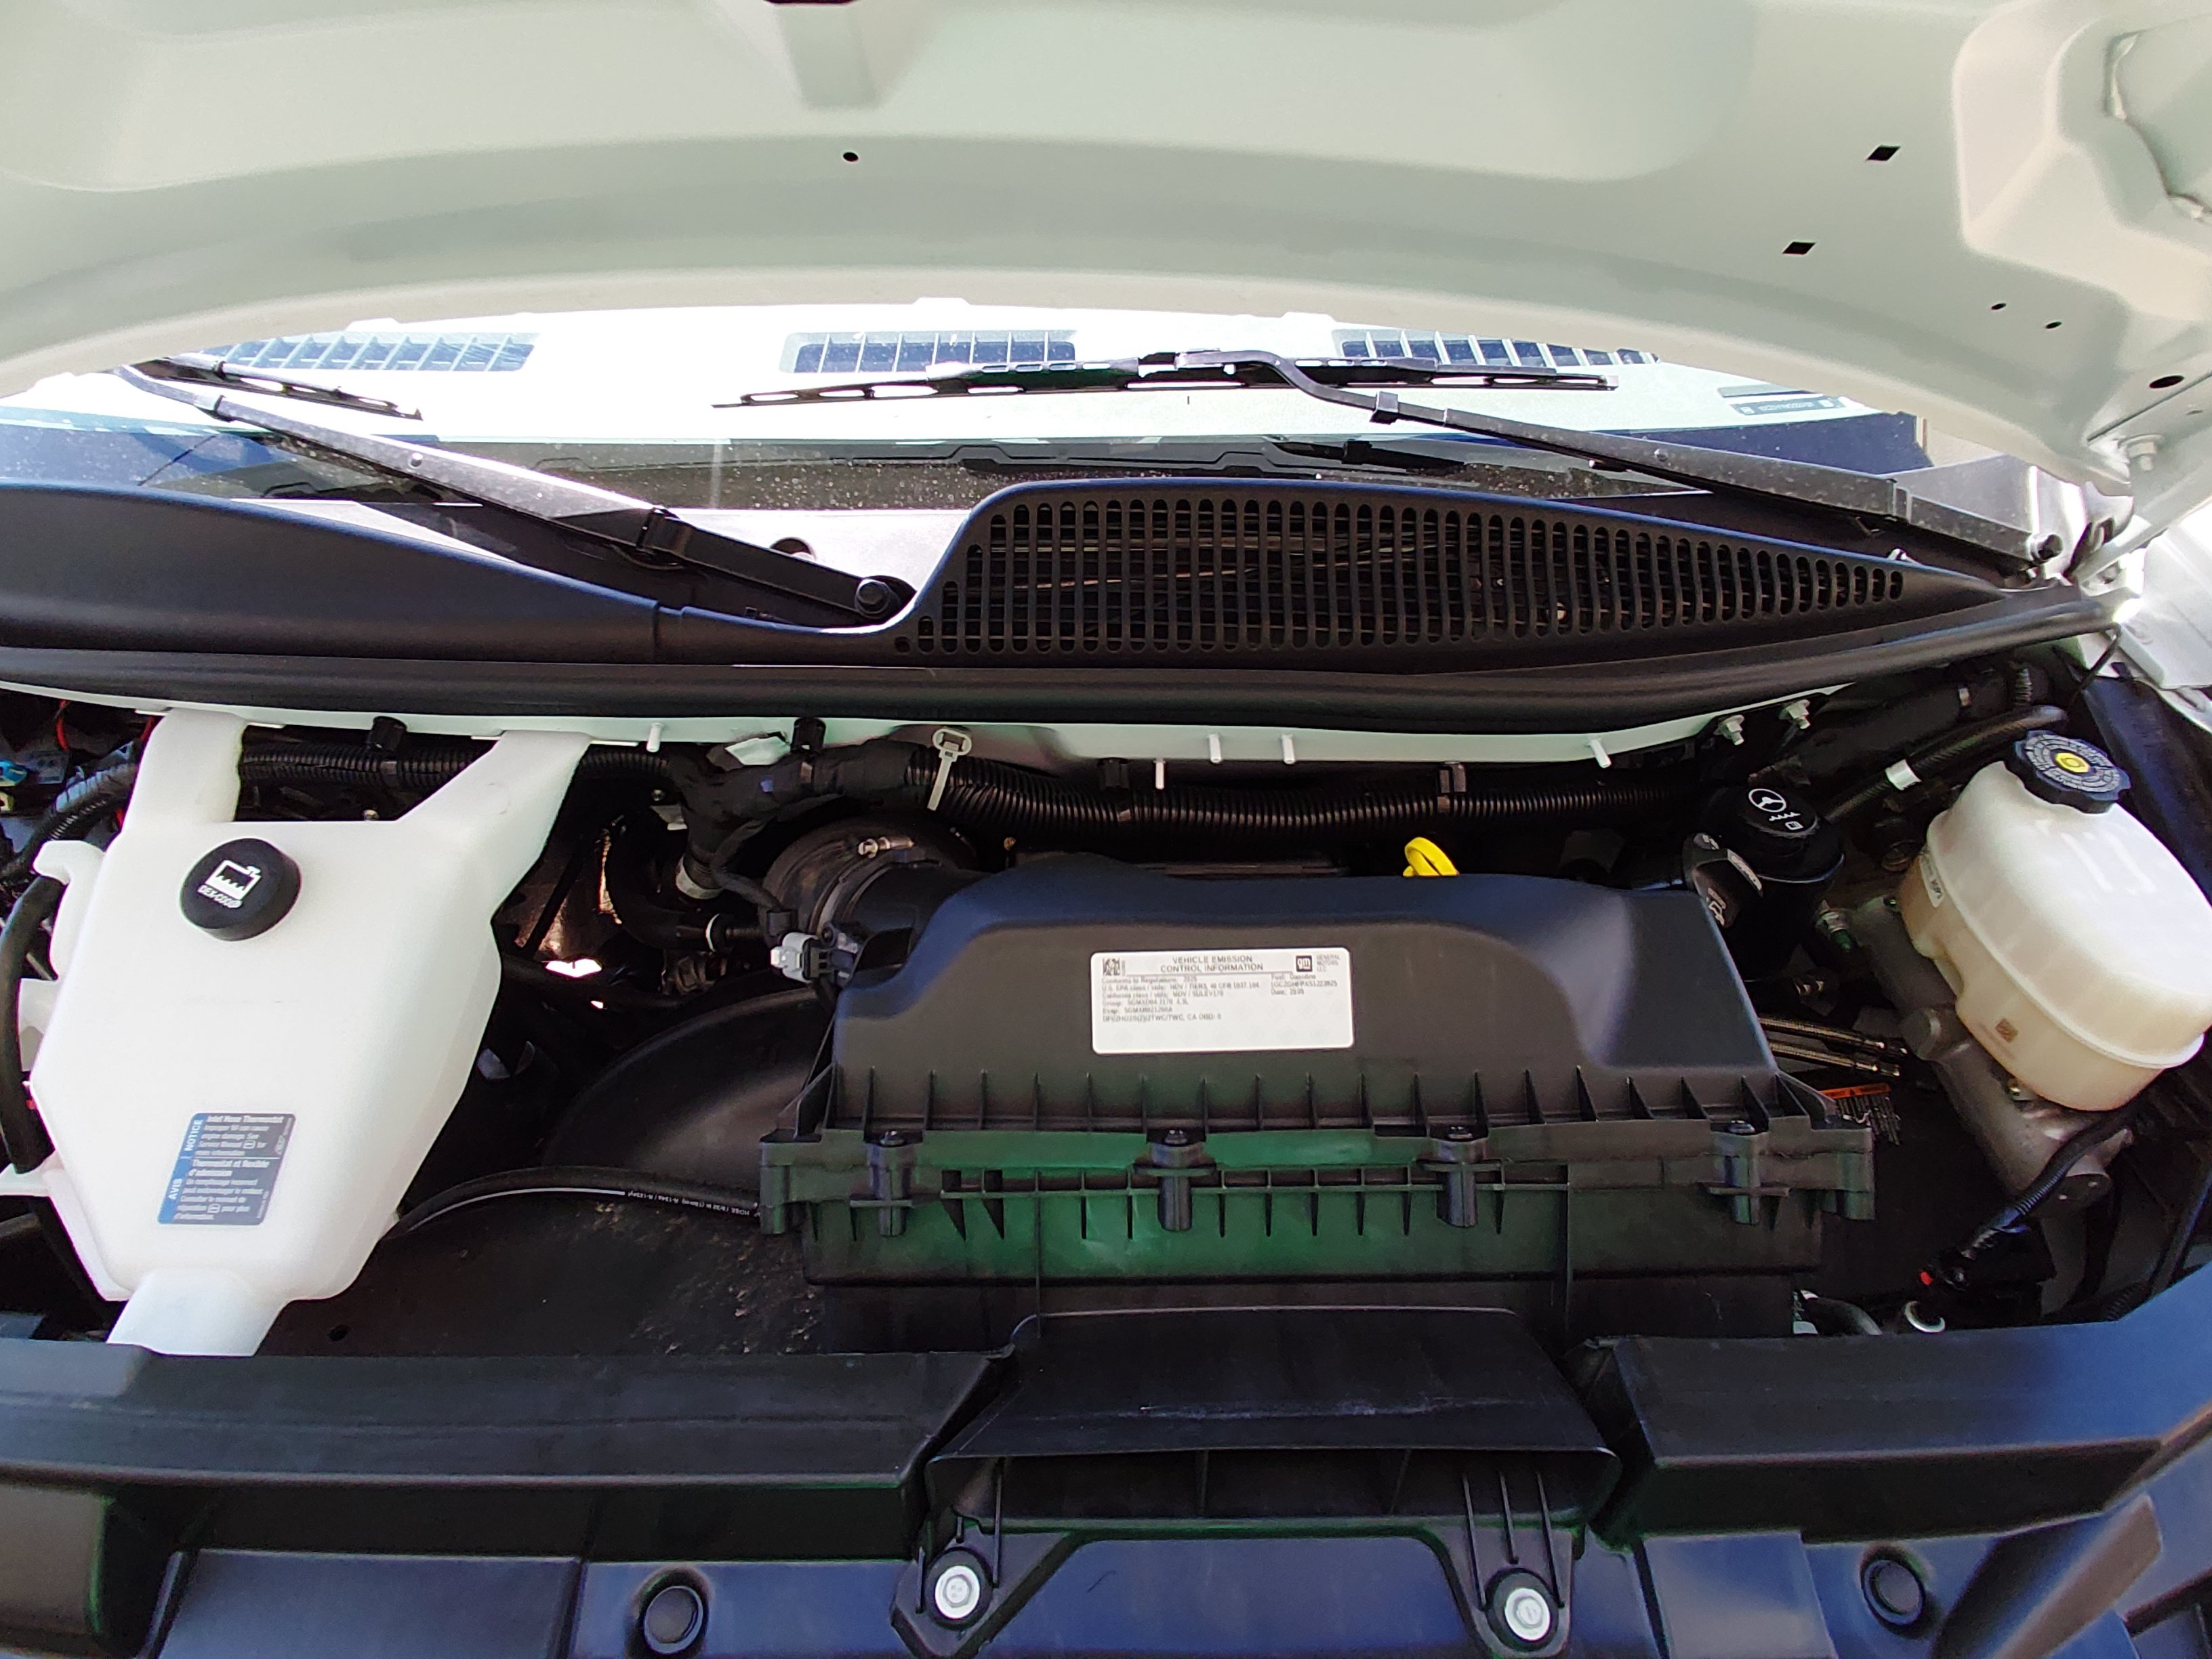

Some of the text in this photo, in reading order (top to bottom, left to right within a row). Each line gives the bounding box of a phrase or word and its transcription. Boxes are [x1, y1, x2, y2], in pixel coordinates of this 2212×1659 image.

[1160, 962, 1263, 972] CONTROL INFORMATION
[1172, 955, 1253, 964] VEHICLE EMISSION
[184, 1120, 203, 1151] NOTICE
[168, 1178, 183, 1200] AVIS
